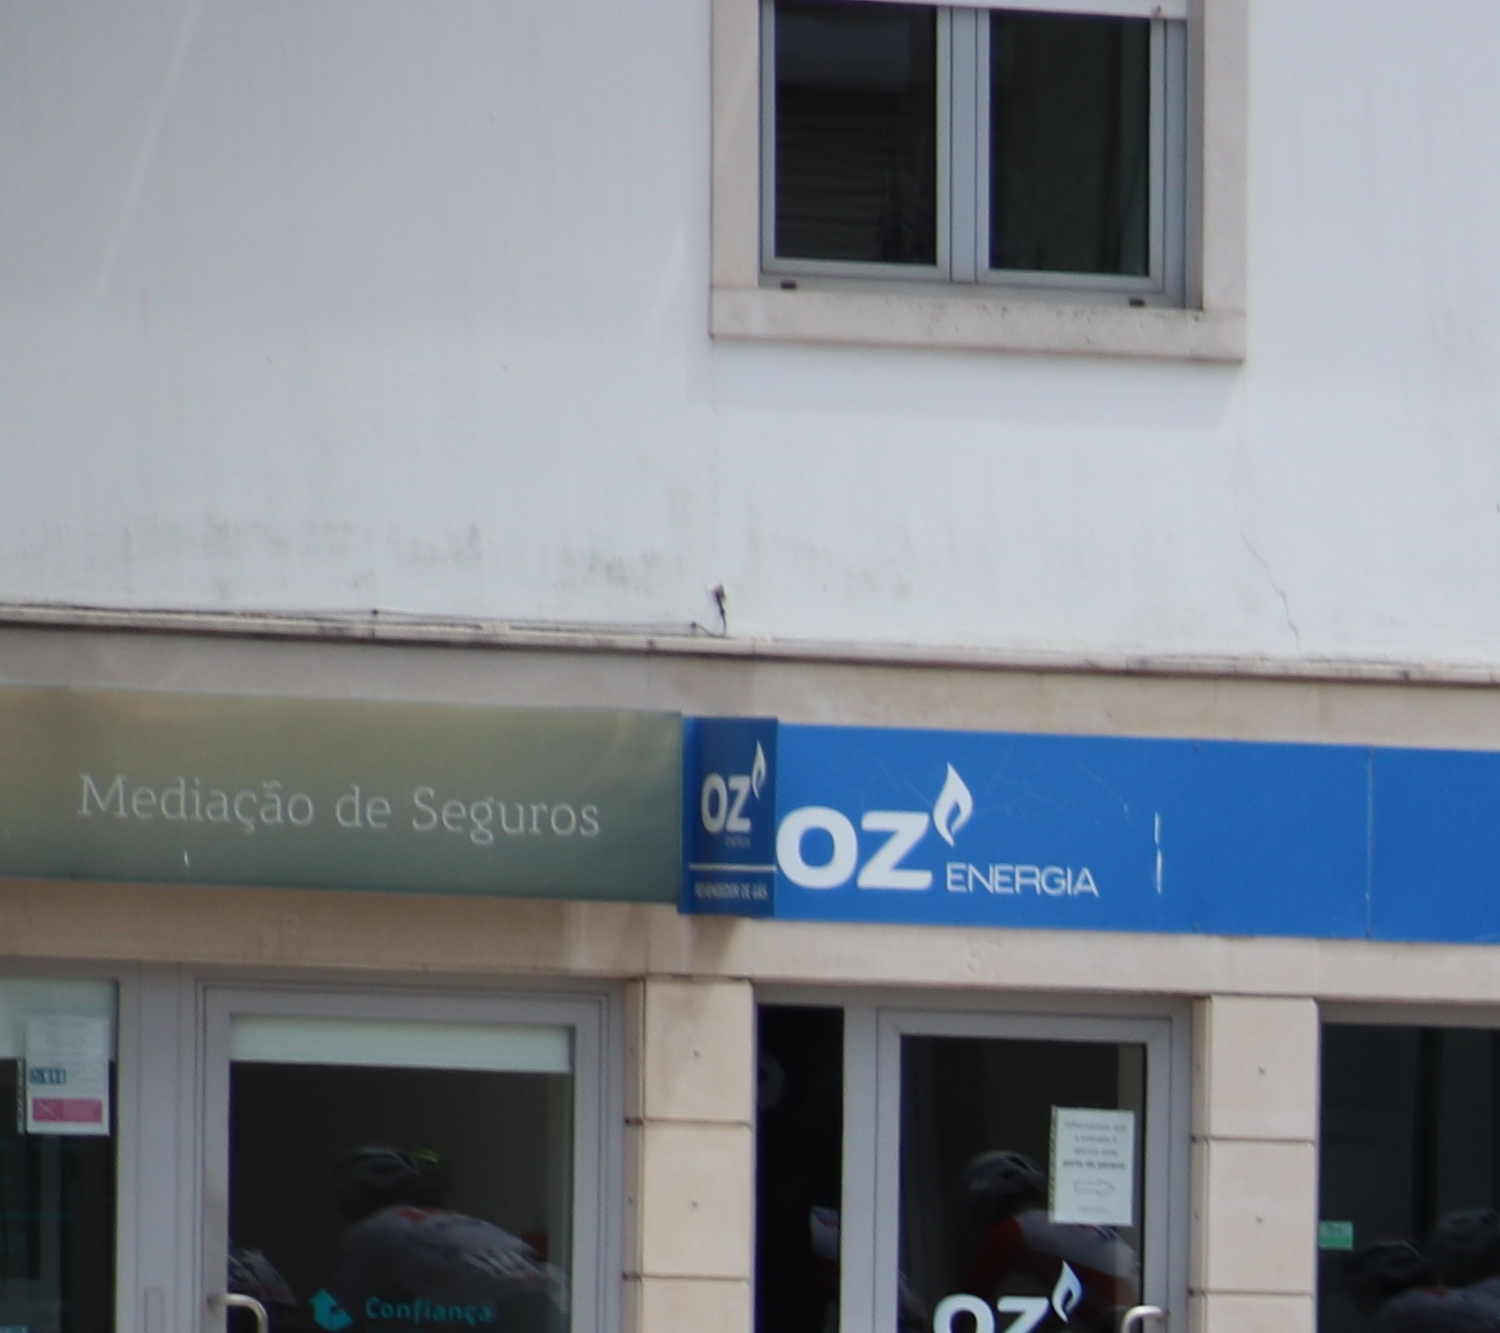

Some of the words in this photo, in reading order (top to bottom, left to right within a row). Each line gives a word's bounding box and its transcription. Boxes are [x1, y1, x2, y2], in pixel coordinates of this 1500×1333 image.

[77, 773, 314, 834] Mediação
[335, 784, 391, 829] de
[412, 786, 600, 846] Seguros
[701, 773, 752, 834] OZ
[775, 804, 934, 889] OZ
[946, 861, 1099, 897] ENERGIA
[365, 1296, 494, 1325] Confiança
